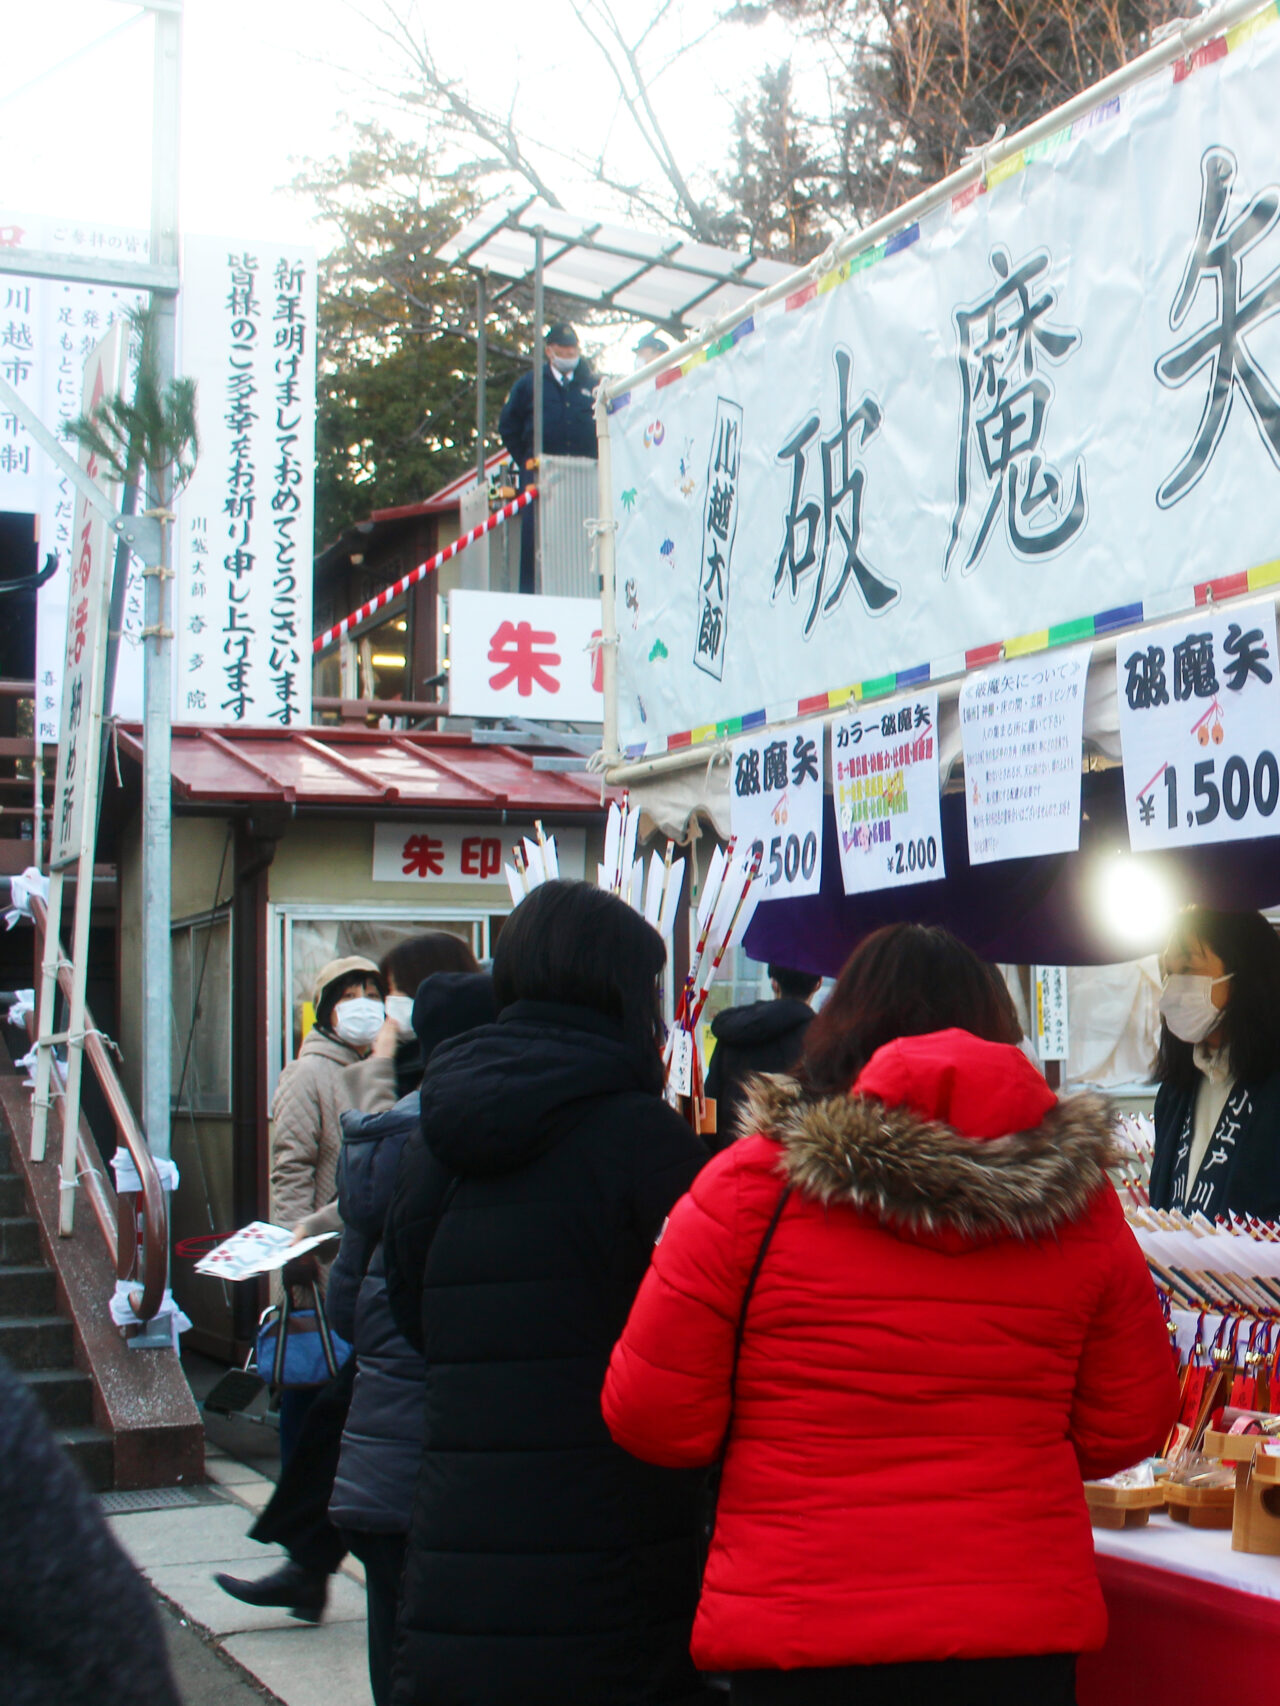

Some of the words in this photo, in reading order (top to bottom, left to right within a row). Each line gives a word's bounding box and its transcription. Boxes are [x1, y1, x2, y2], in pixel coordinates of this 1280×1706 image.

[2, 286, 33, 387] 川越市
[699, 417, 739, 661] 川越大師
[1124, 623, 1274, 711] 破魔矢
[837, 704, 931, 748] カラー破魔矢
[735, 735, 819, 797] 破魔矢
[1138, 749, 1280, 829] ¥1,500
[402, 834, 540, 878] 朱印
[743, 831, 817, 887] 2,500
